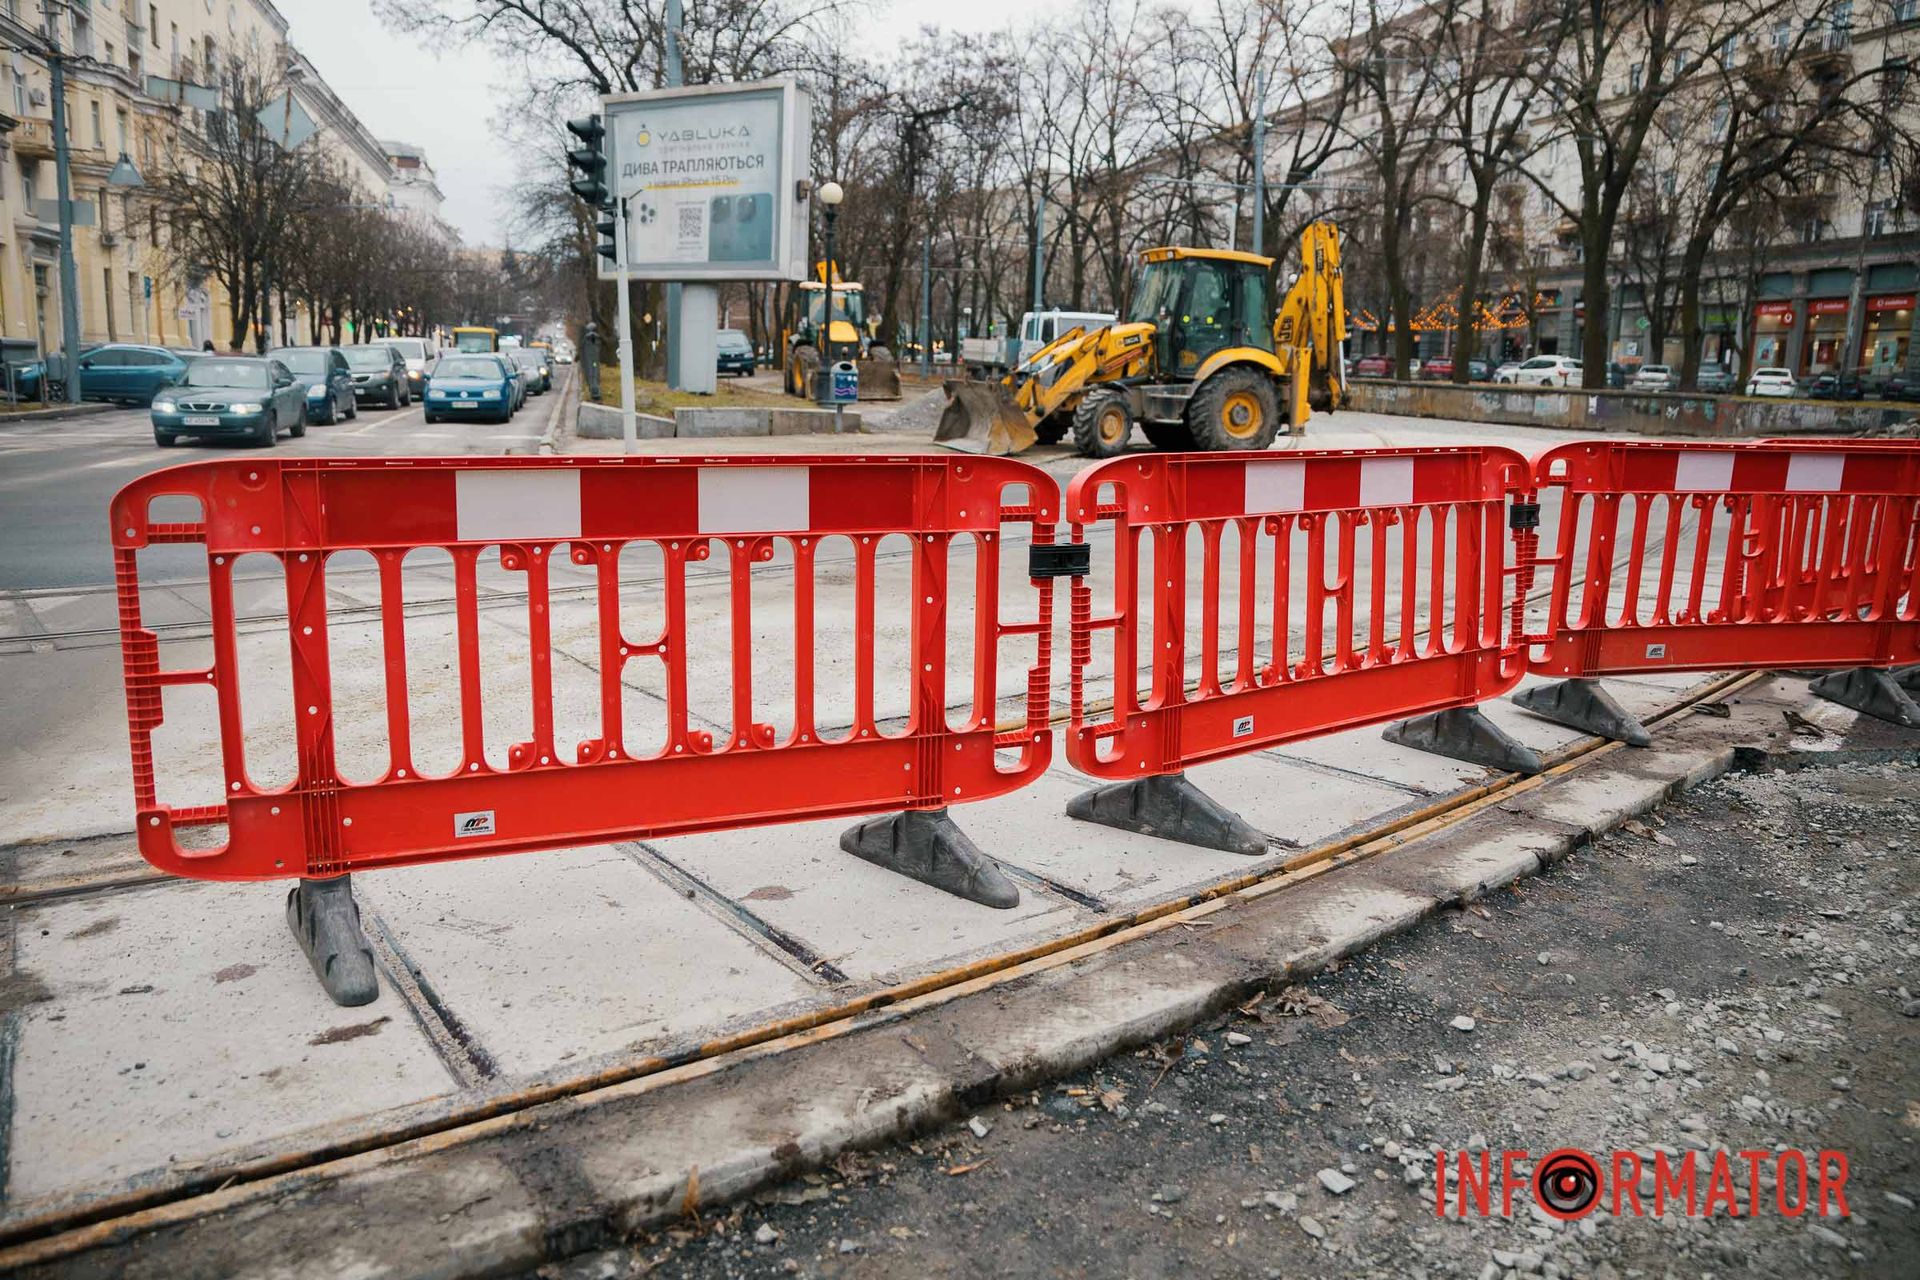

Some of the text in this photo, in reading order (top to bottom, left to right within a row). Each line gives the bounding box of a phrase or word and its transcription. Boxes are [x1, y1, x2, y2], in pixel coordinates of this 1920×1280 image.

[657, 125, 751, 141] YABLUKA
[622, 154, 765, 179] ДИВА ТРАПЛЯЮТЬСЯ
